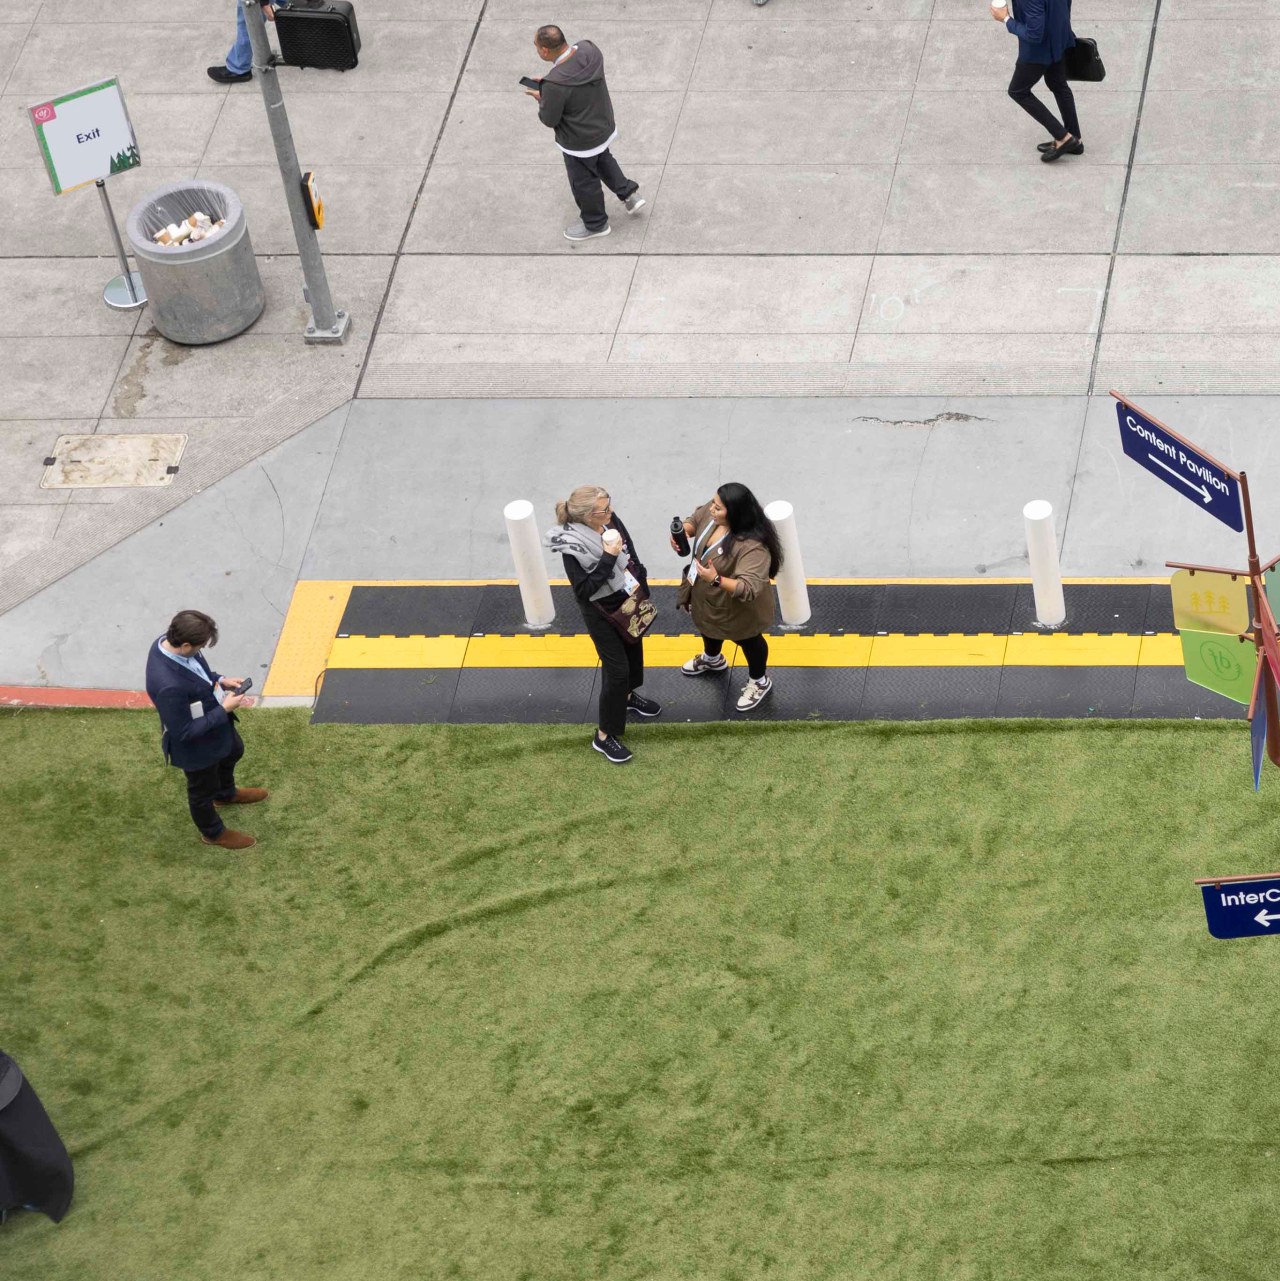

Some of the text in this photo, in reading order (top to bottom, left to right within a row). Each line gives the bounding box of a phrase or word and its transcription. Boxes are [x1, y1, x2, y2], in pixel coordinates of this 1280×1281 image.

[76, 127, 101, 144] Exit
[1126, 416, 1230, 496] Content Pavilion
